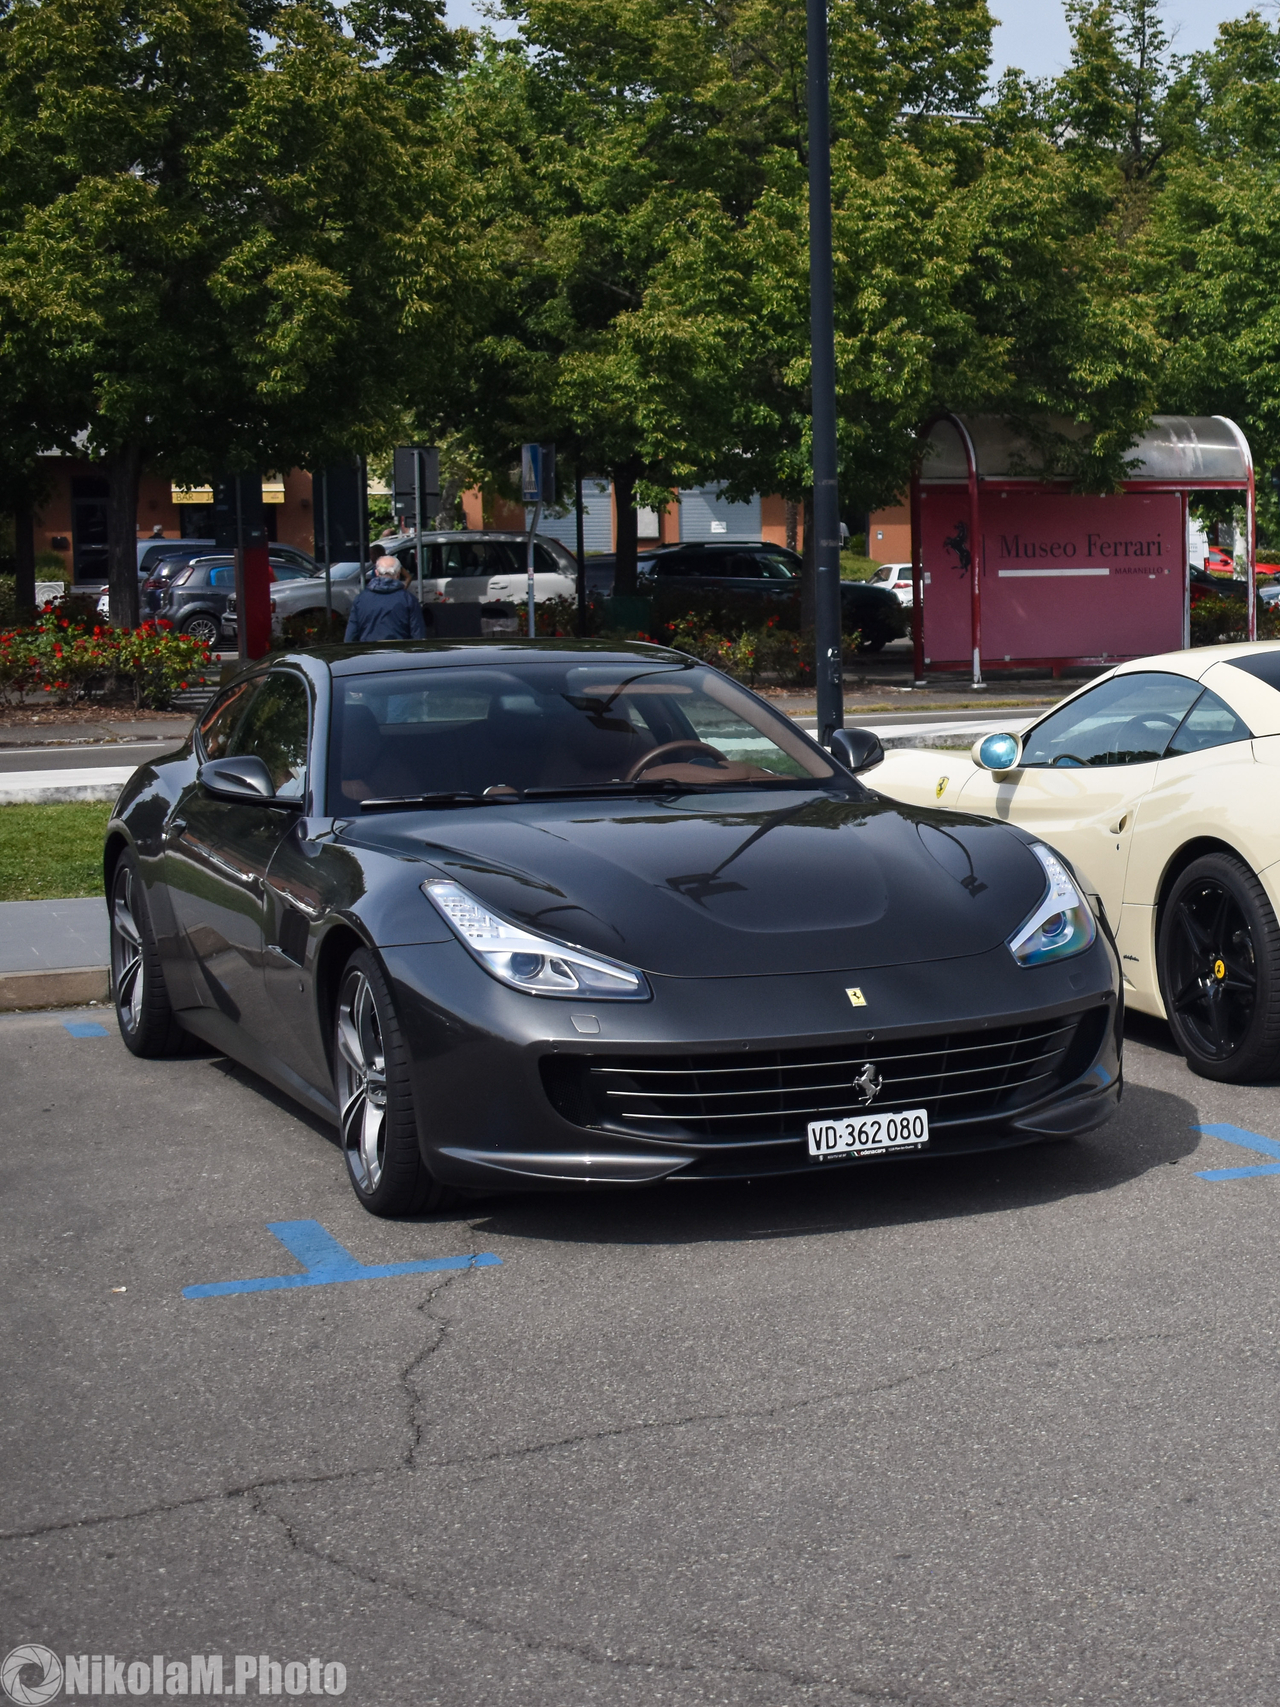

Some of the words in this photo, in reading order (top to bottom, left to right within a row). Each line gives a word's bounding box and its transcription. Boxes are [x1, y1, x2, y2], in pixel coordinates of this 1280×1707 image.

[176, 494, 194, 502] BAR
[1000, 535, 1076, 558] Museo
[1086, 533, 1162, 557] Ferrari
